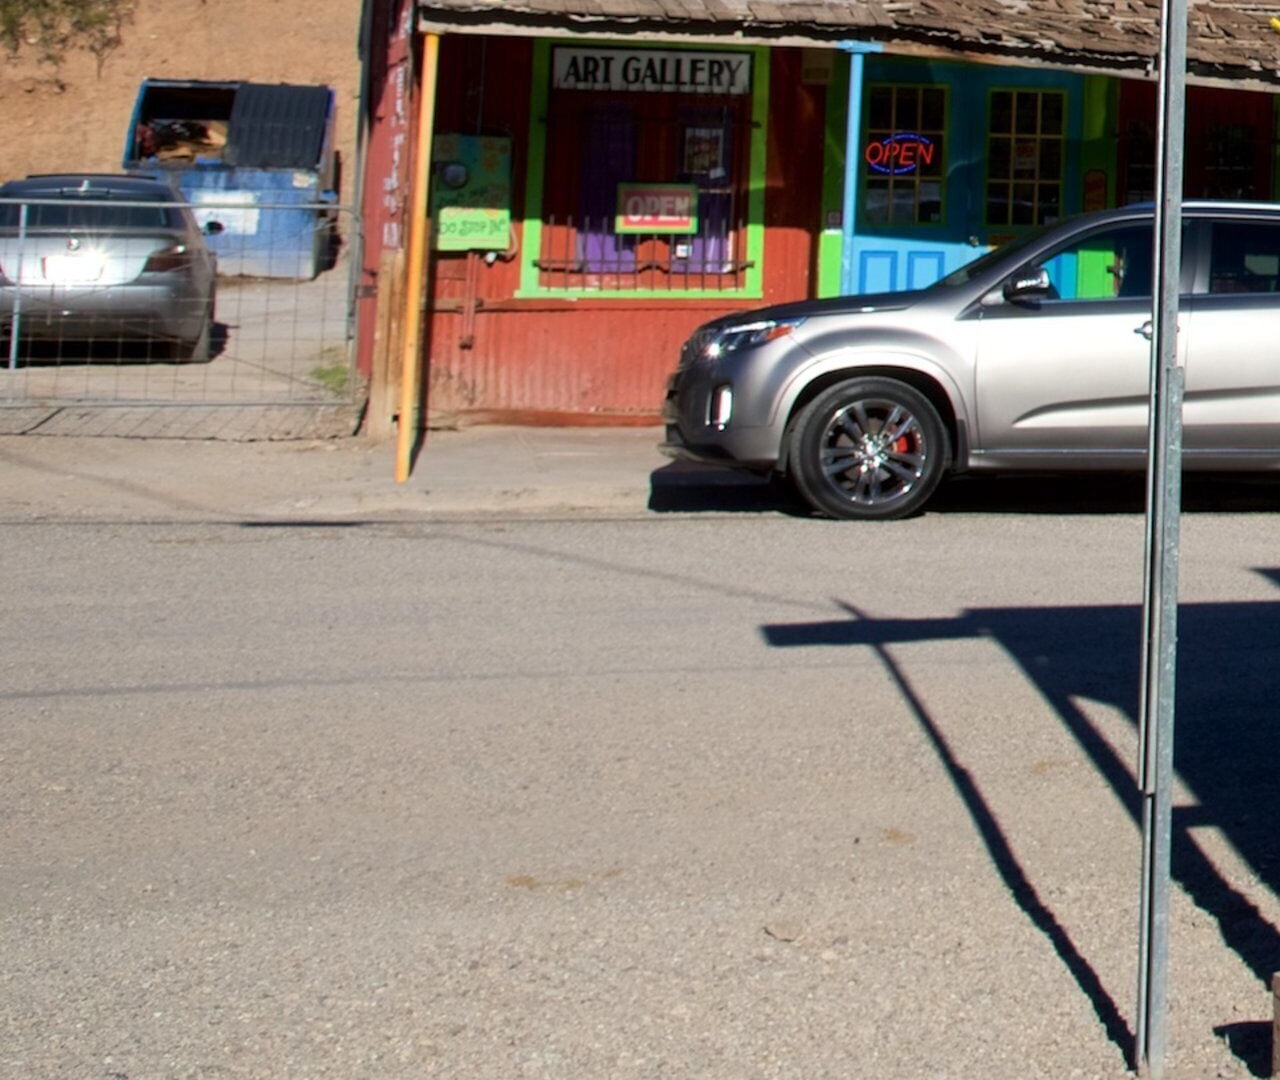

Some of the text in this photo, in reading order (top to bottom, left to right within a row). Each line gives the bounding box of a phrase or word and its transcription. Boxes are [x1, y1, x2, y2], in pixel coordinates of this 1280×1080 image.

[564, 55, 745, 87] ART GALLERY
[865, 142, 934, 166] OPEN
[626, 196, 689, 222] OPEN
